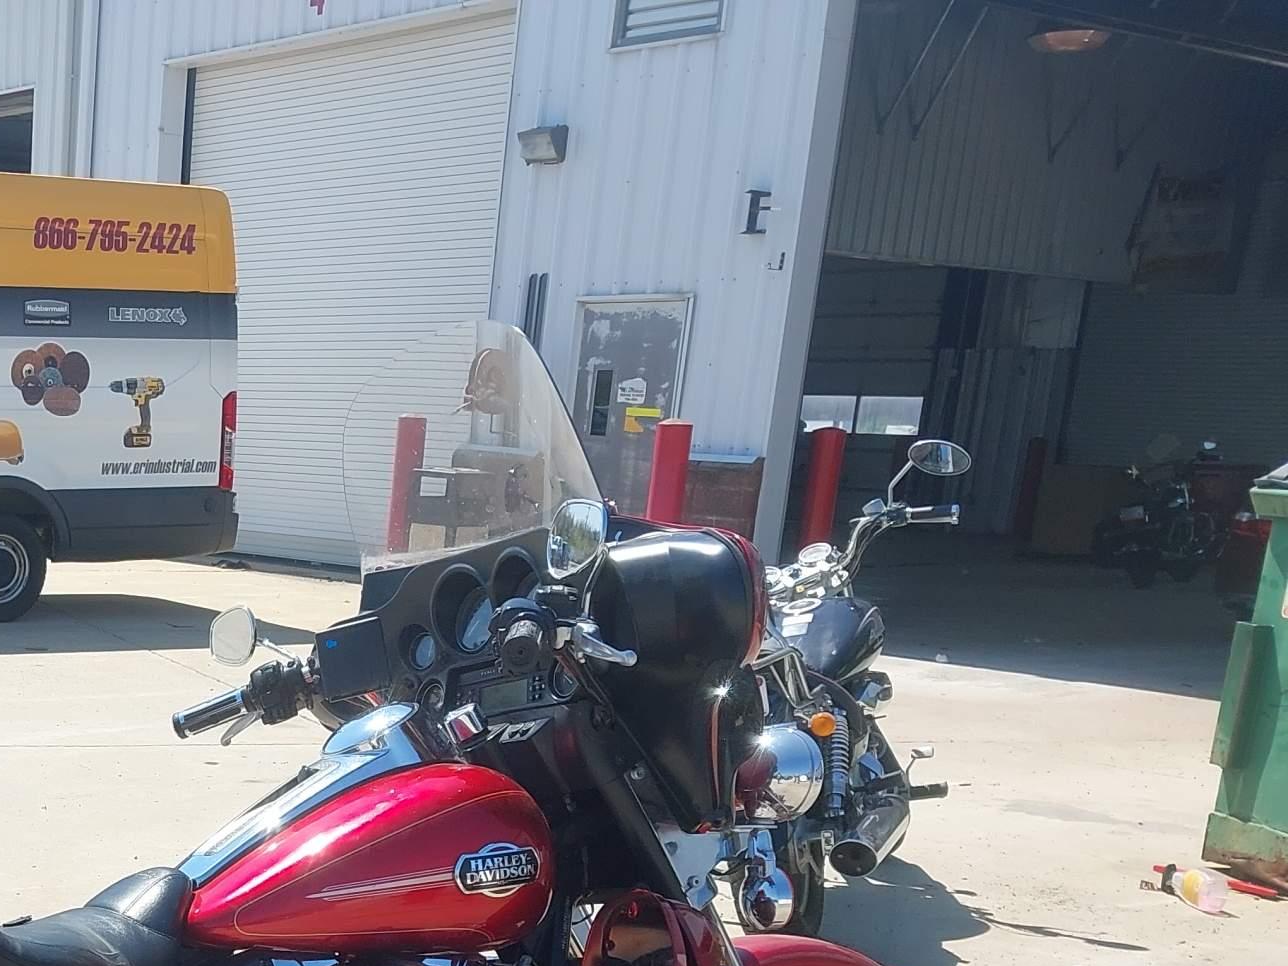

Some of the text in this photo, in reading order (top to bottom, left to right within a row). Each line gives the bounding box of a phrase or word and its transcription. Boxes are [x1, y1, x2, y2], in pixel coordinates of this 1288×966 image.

[33, 216, 196, 255] 866-795-2424
[26, 304, 68, 313] Rubbermaid
[108, 307, 171, 323] LENOX
[101, 459, 217, 475] www.erindustrial.com
[469, 853, 532, 872] HARLEY-
[465, 863, 535, 885] DAVIDSON
